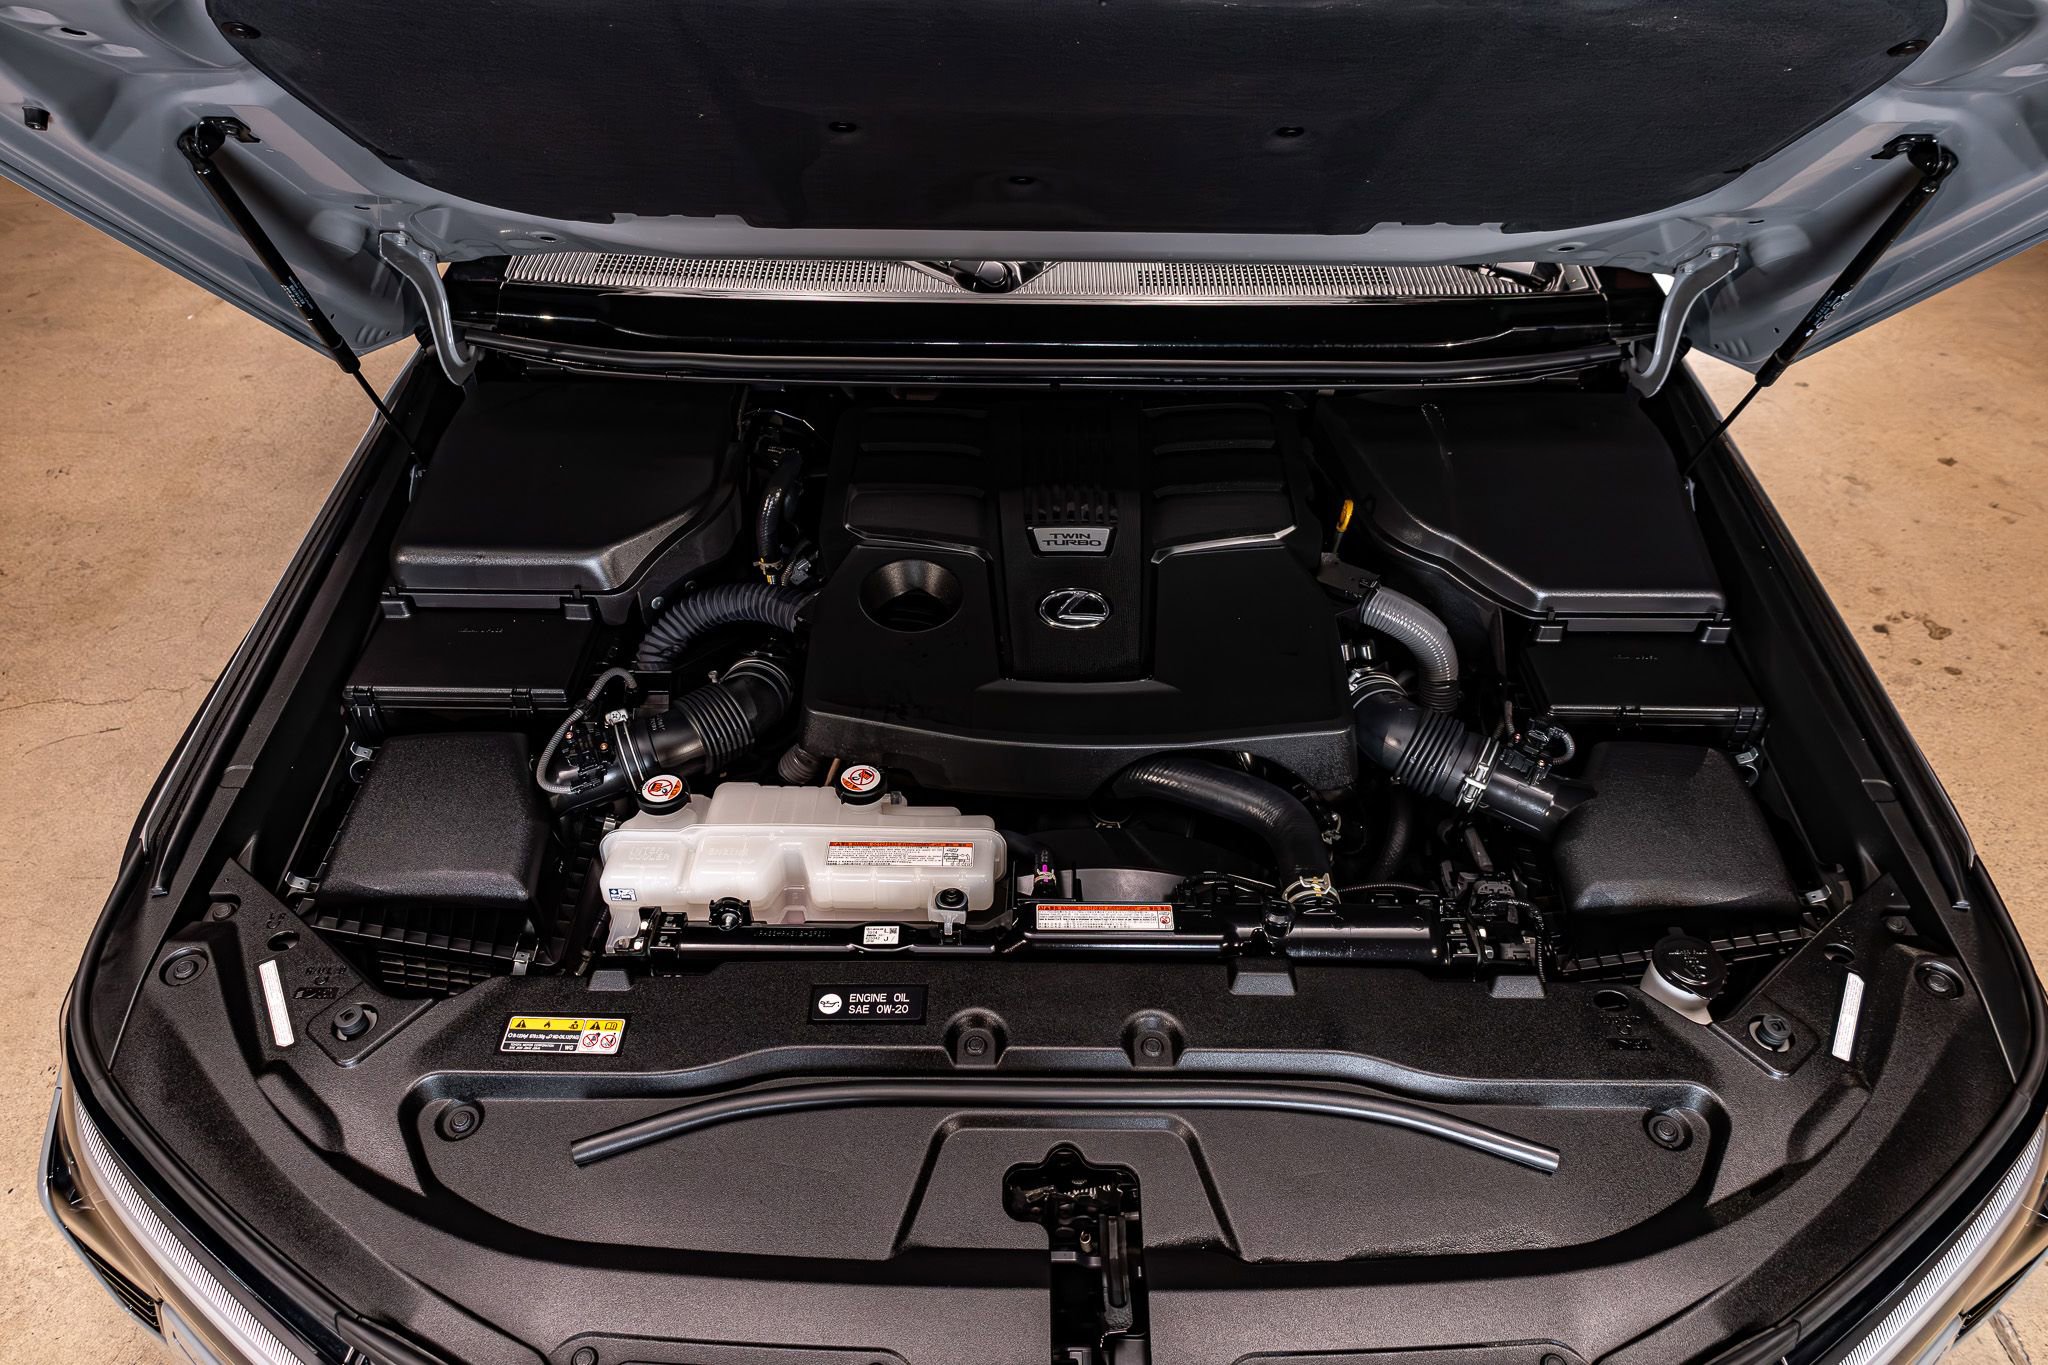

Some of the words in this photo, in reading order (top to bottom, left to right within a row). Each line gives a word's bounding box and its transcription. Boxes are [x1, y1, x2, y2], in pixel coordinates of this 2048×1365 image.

[849, 993, 888, 1003] ENGINE
[893, 993, 910, 1003] OIL
[848, 1005, 870, 1014] SAE
[876, 1005, 909, 1014] 0W-20
